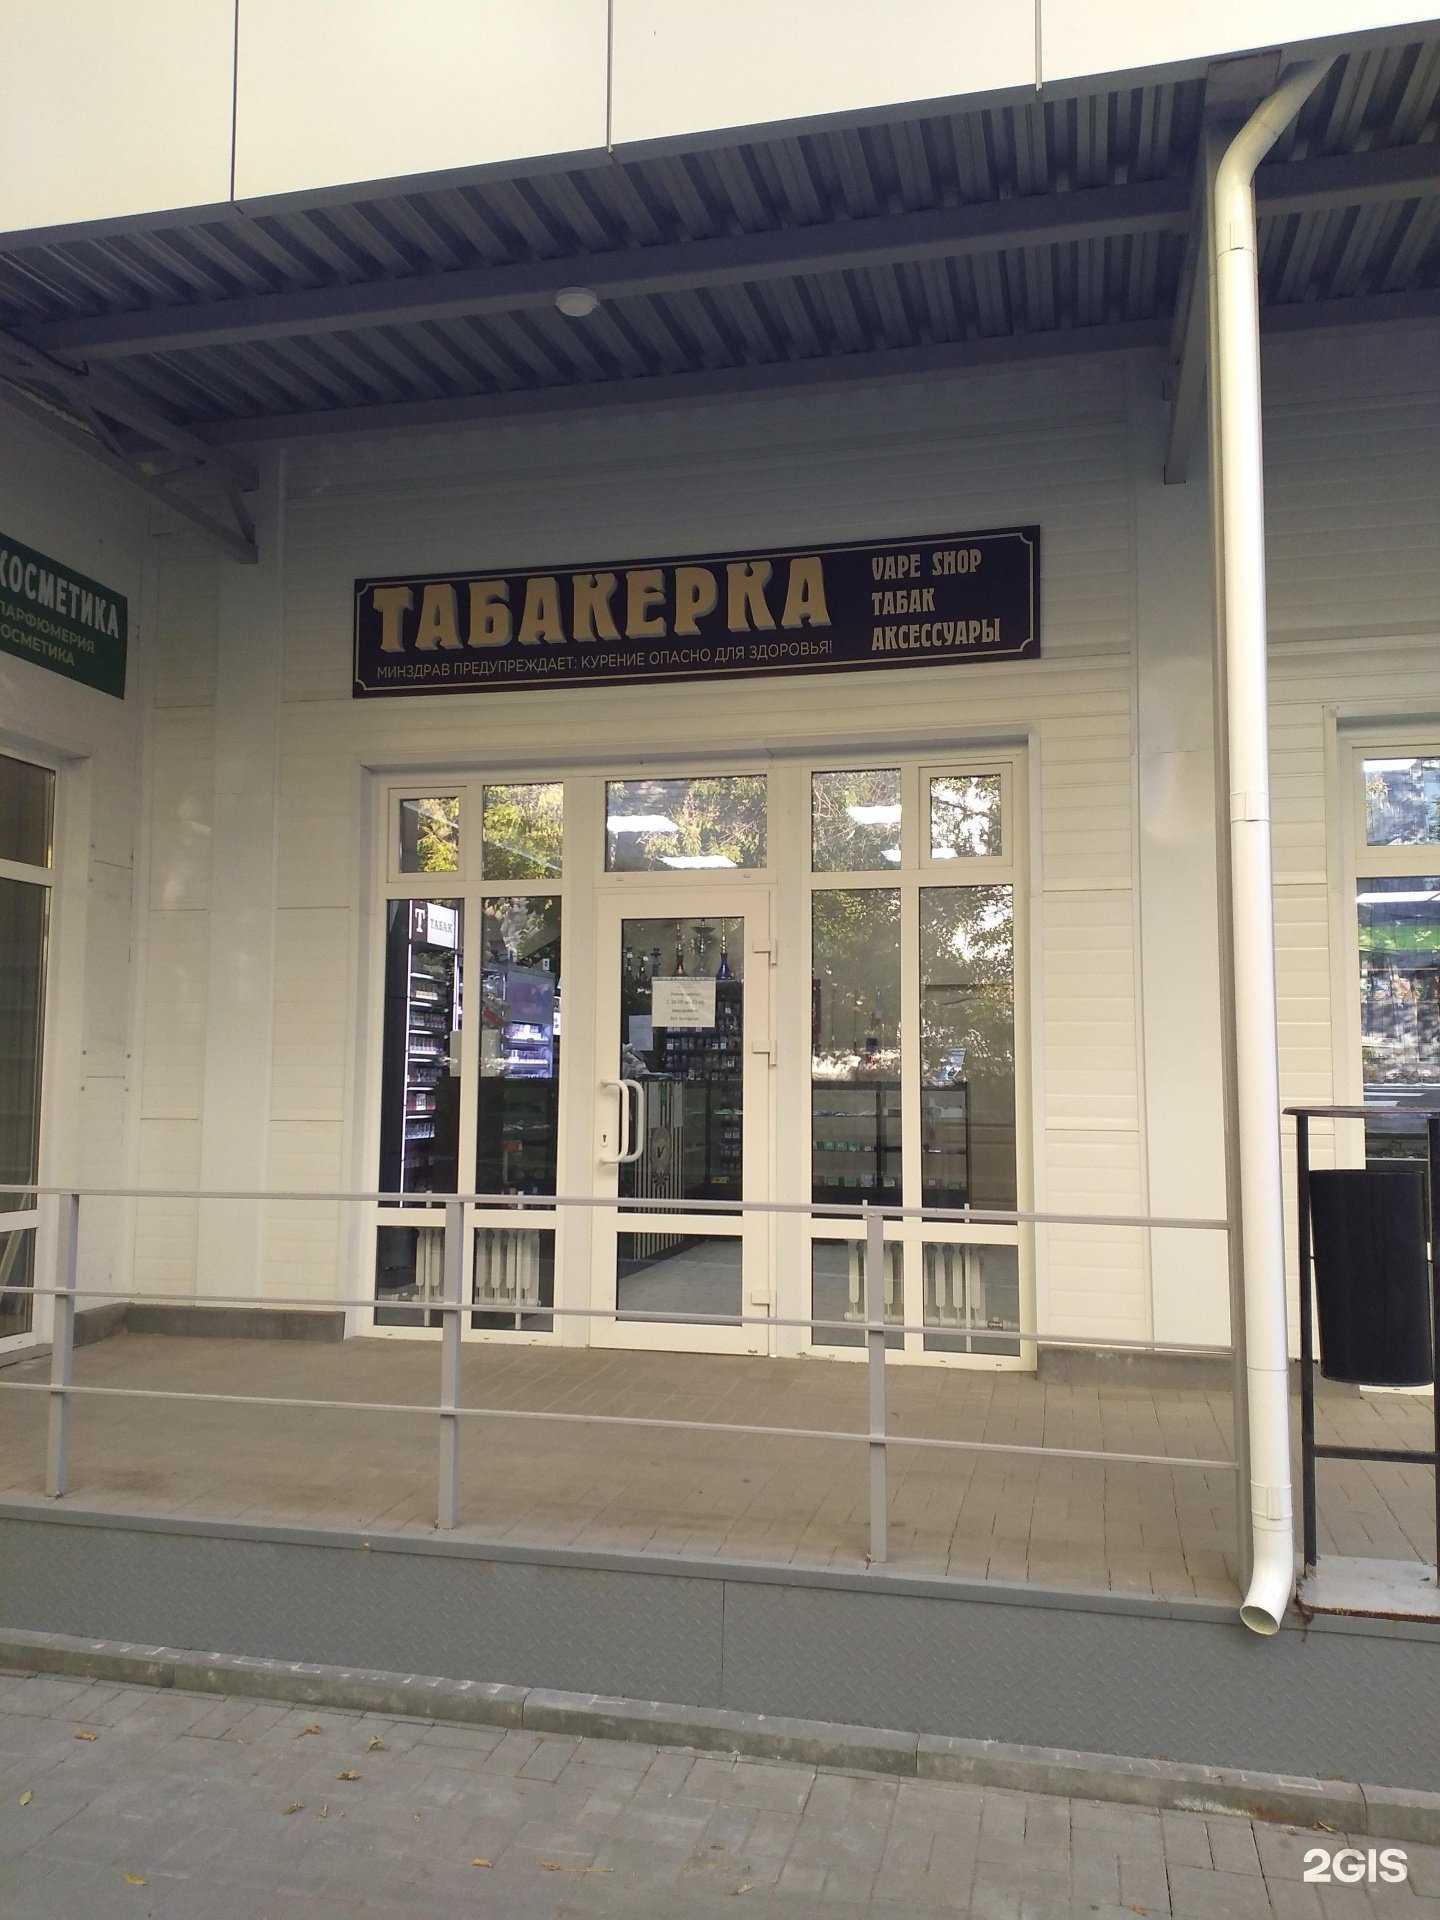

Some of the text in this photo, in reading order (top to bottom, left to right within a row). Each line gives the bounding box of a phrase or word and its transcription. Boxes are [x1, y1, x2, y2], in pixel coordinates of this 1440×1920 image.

[871, 548, 983, 581] VAPE SHOP
[372, 555, 832, 653] ТАБАКЕРКА
[871, 587, 936, 616] ТАБАК
[0, 620, 76, 666] ОСМЕТИКА
[871, 617, 1001, 651] АКСЕССУАРЫ
[377, 663, 450, 679] МИНЗДРАВ
[581, 652, 645, 669] КУРЕНИЕ
[649, 648, 711, 665] ОПАСНО
[714, 645, 745, 663] ДЛЯ
[749, 639, 833, 661] ЗДОРОВЬЯ!
